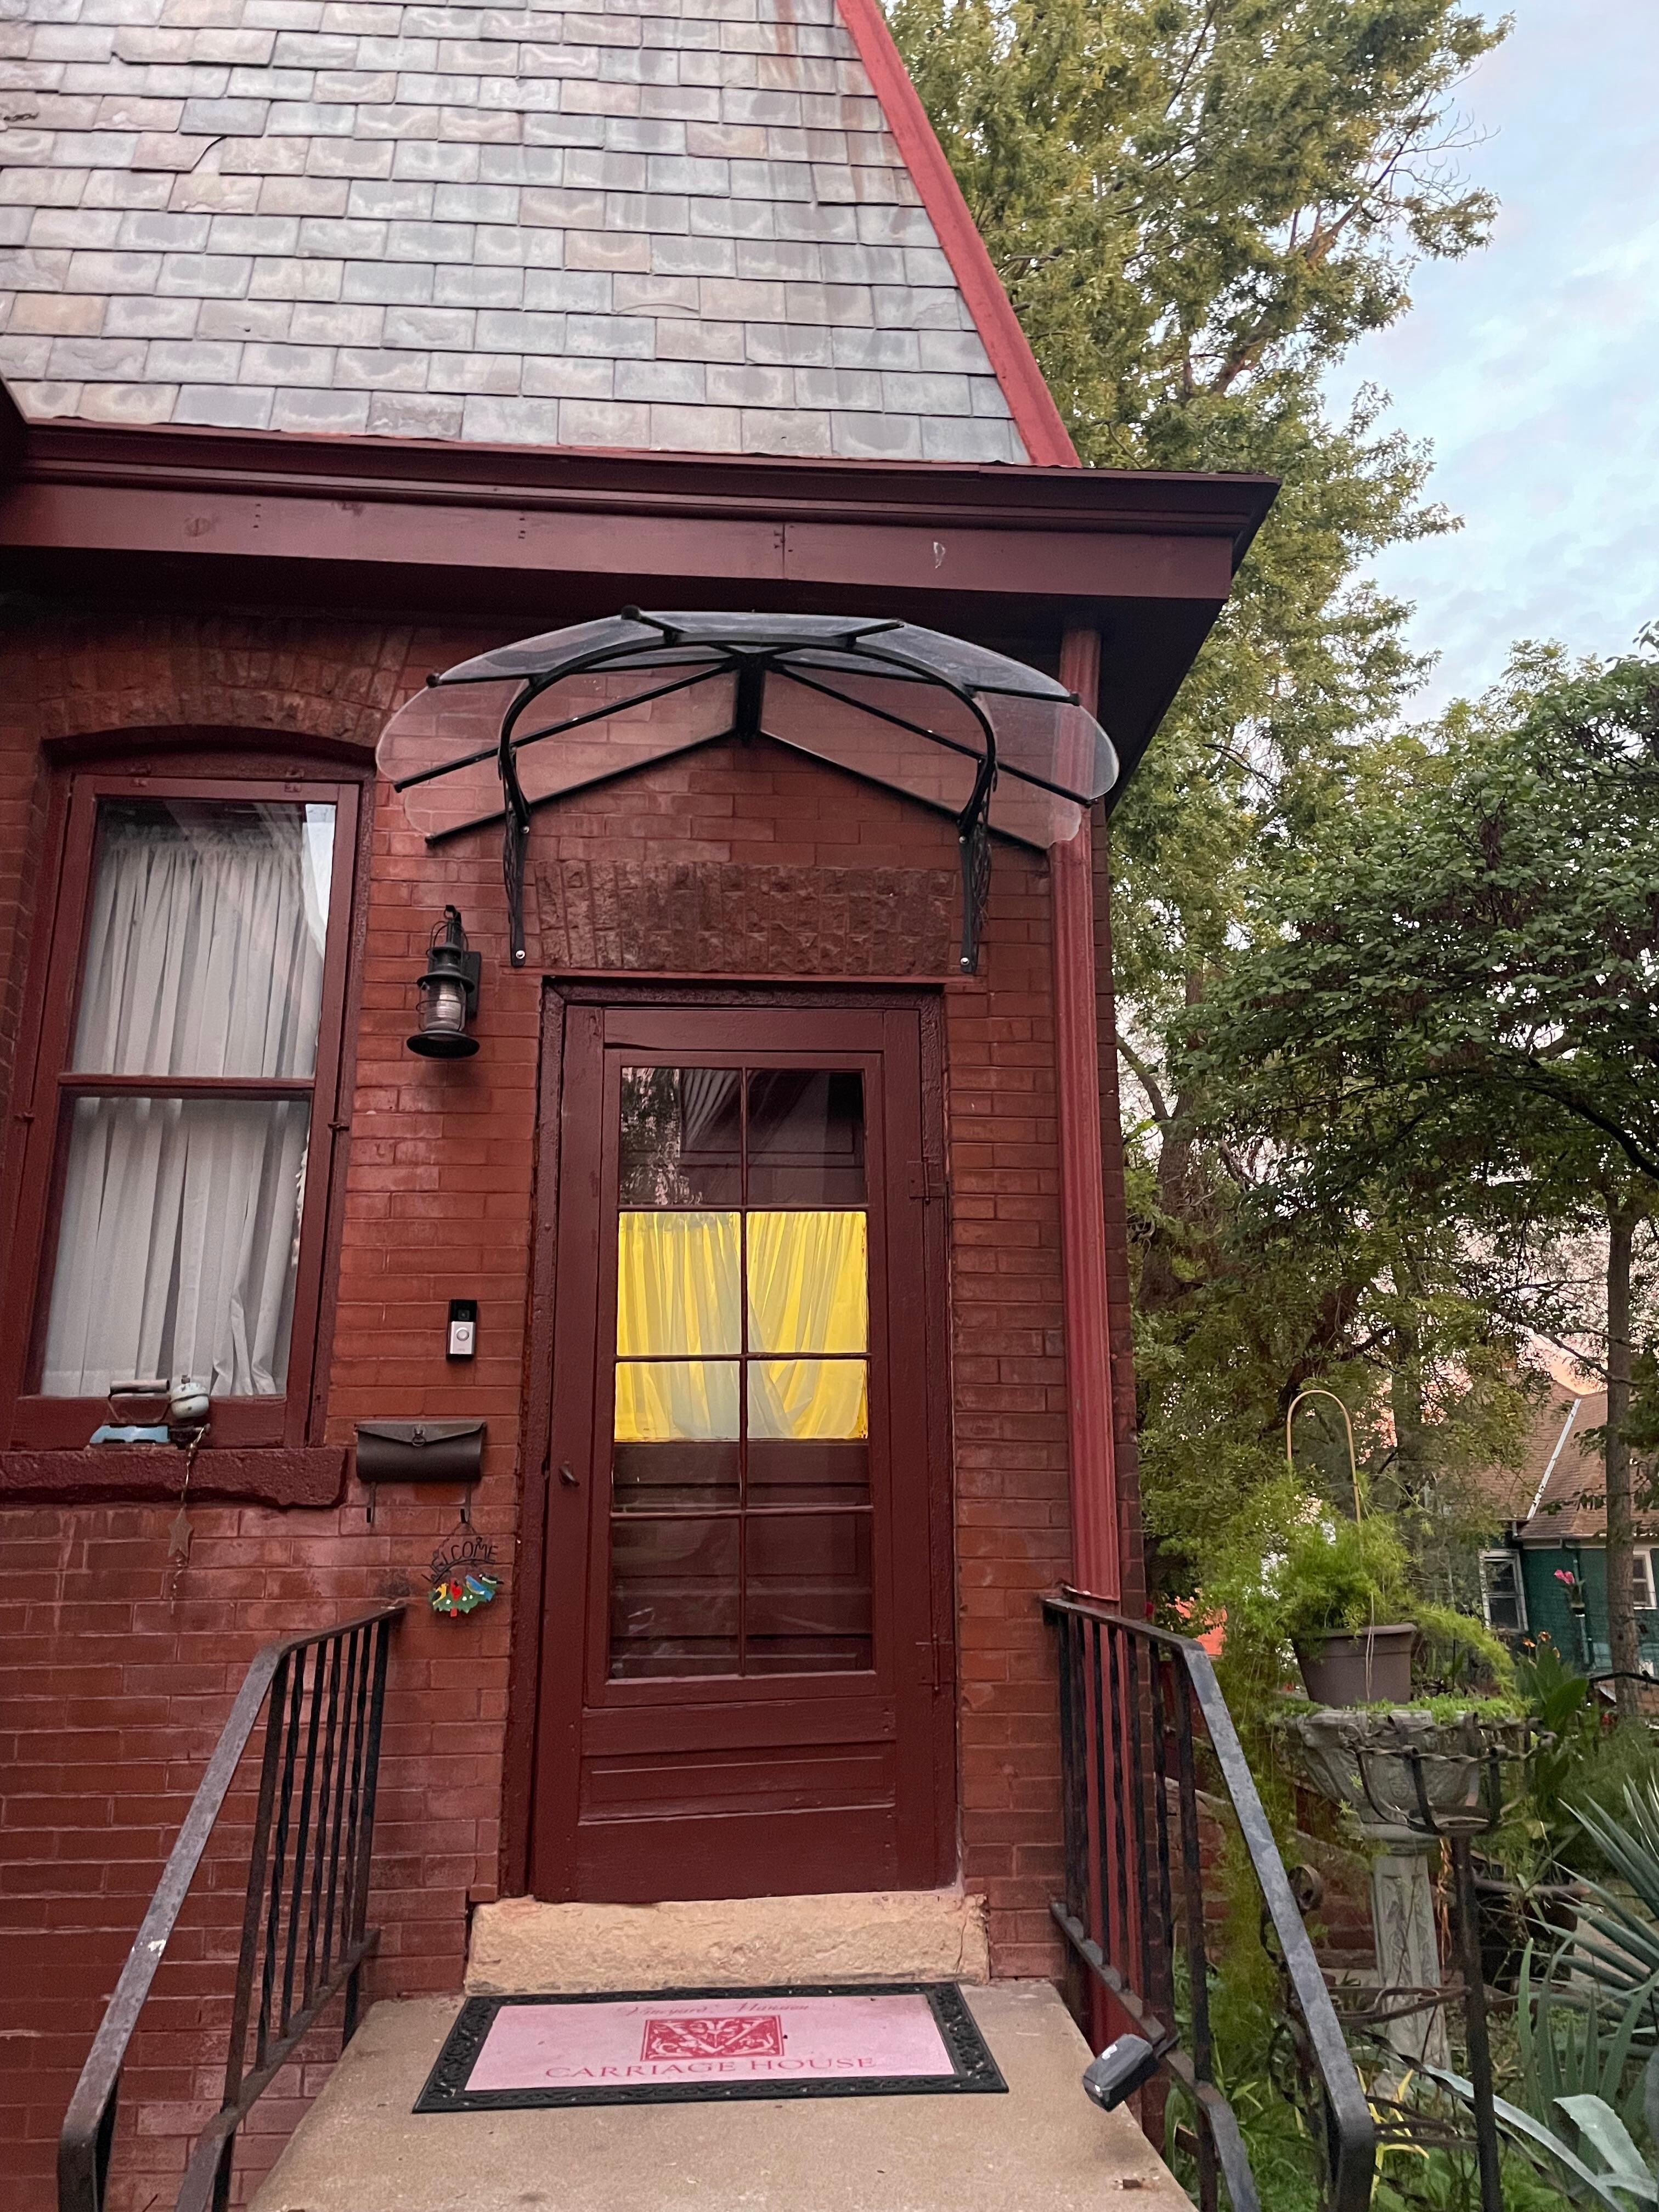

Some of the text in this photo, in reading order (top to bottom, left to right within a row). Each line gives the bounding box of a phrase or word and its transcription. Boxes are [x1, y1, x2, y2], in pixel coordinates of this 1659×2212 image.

[421, 1539, 499, 1585] WELCOME
[545, 2057, 876, 2078] CARRIAGE HOUSE
